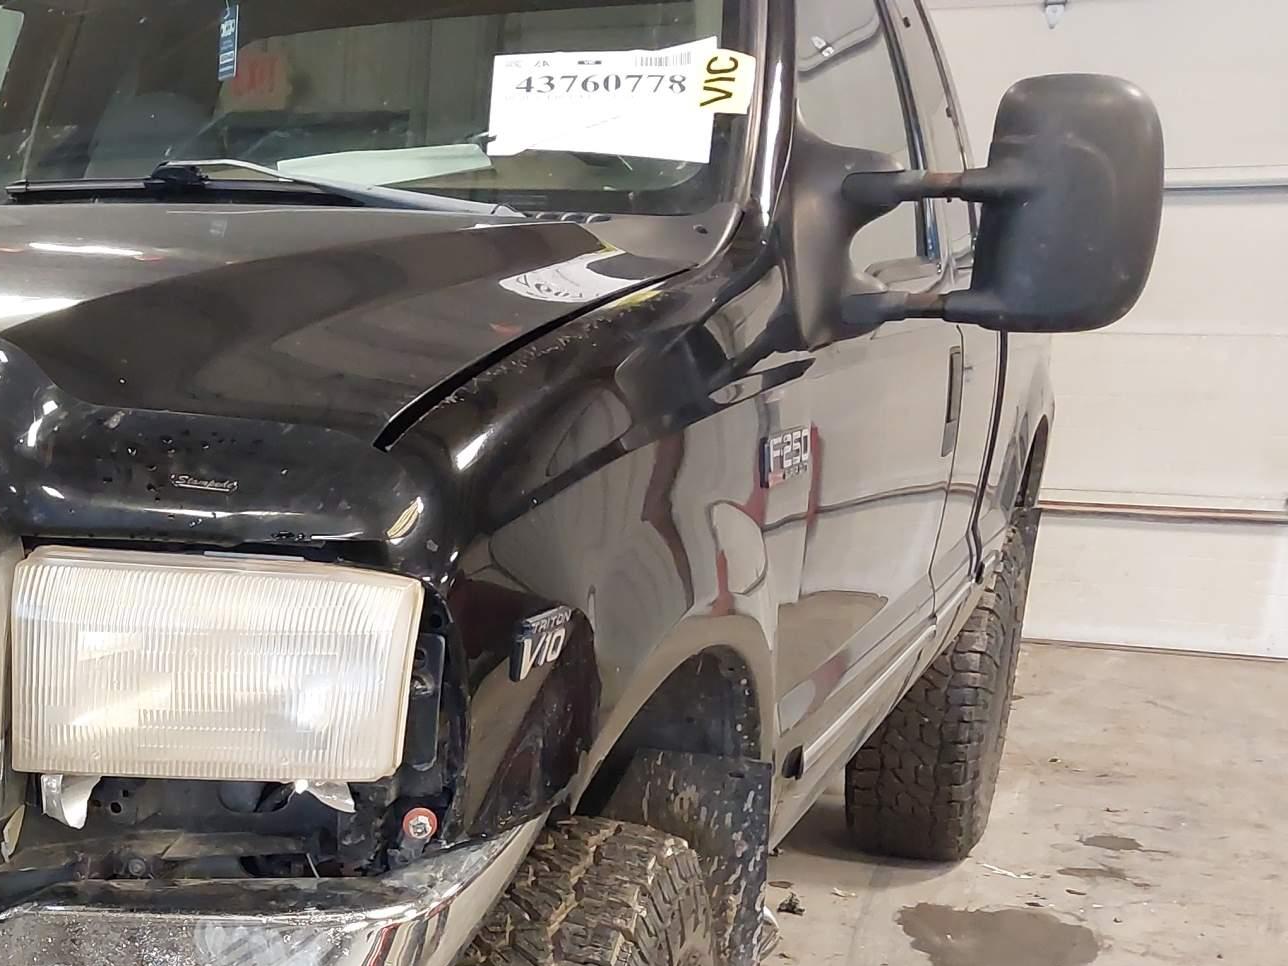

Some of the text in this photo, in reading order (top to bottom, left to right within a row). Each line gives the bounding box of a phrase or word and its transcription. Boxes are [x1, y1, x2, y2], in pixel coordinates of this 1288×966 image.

[514, 73, 687, 94] 43760778
[700, 56, 739, 107] VIC
[175, 475, 234, 490] Stampede
[531, 609, 572, 634] TRITON
[520, 628, 566, 681] V10
